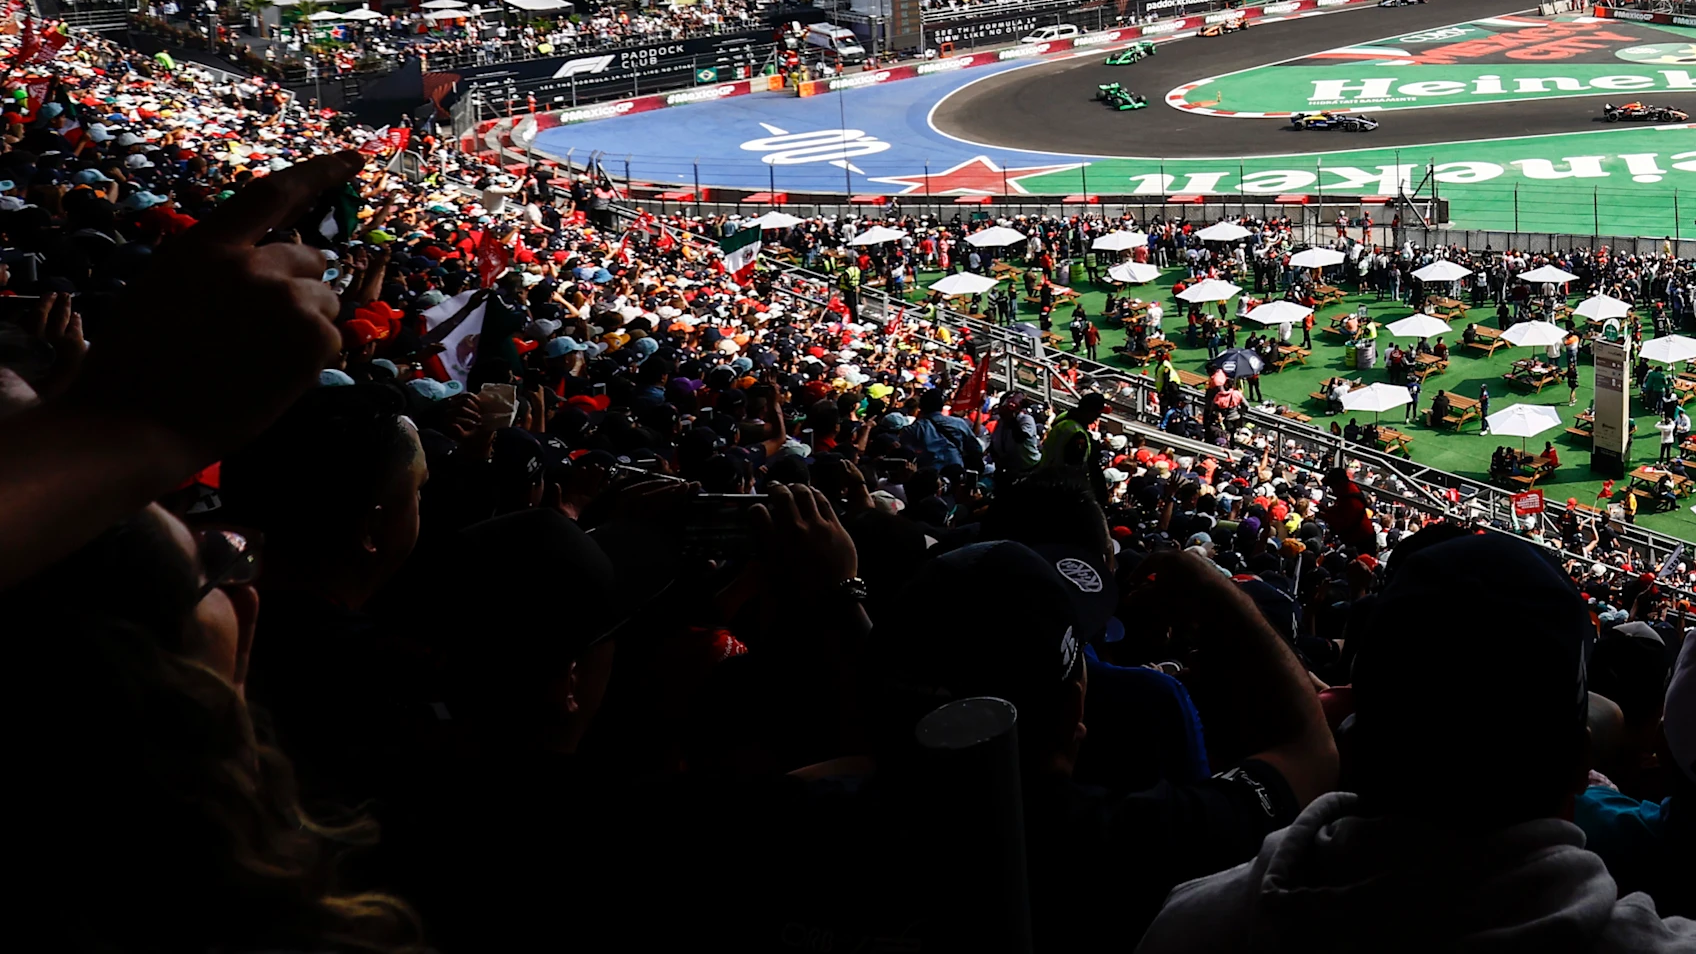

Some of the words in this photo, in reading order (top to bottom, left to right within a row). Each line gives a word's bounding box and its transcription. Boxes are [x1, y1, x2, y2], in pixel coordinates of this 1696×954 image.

[1614, 10, 1653, 20] #MexicoGP
[980, 19, 1022, 30] FORMULA
[935, 35, 959, 44] VIW
[1074, 32, 1120, 46] #MexicoGP
[621, 45, 684, 60] PADDOCK
[999, 43, 1050, 60] #MexicoGP
[621, 57, 657, 69] CLUB
[918, 56, 974, 74] #MexicoGP
[829, 71, 890, 90] #MexicoGP
[667, 85, 735, 105] #MexicoGP
[560, 102, 634, 123] #MexicoGP
